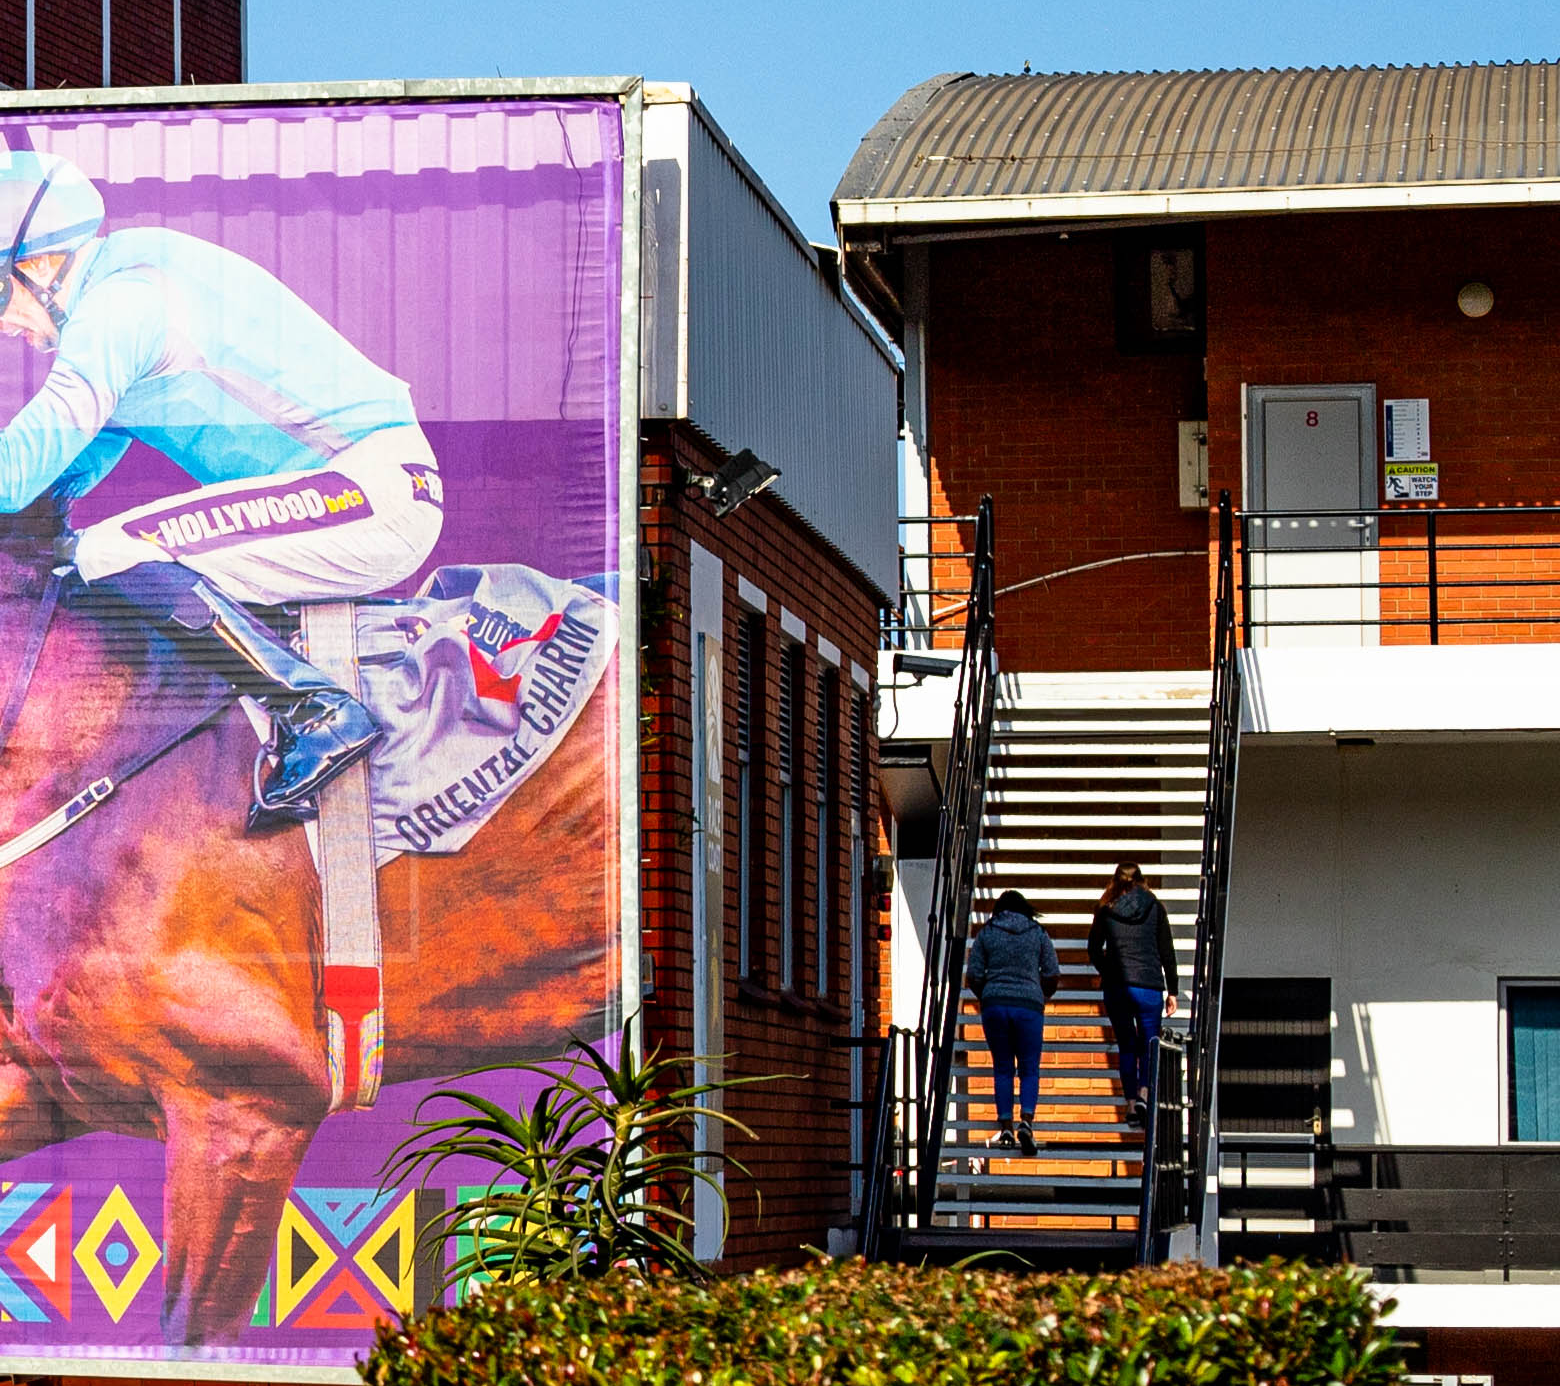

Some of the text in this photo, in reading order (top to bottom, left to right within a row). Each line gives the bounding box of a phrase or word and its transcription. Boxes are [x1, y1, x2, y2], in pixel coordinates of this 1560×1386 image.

[1306, 411, 1318, 427] 8
[157, 488, 365, 549] HOLLYWOOD bets
[394, 613, 600, 842] ORIENTAL CHARM
